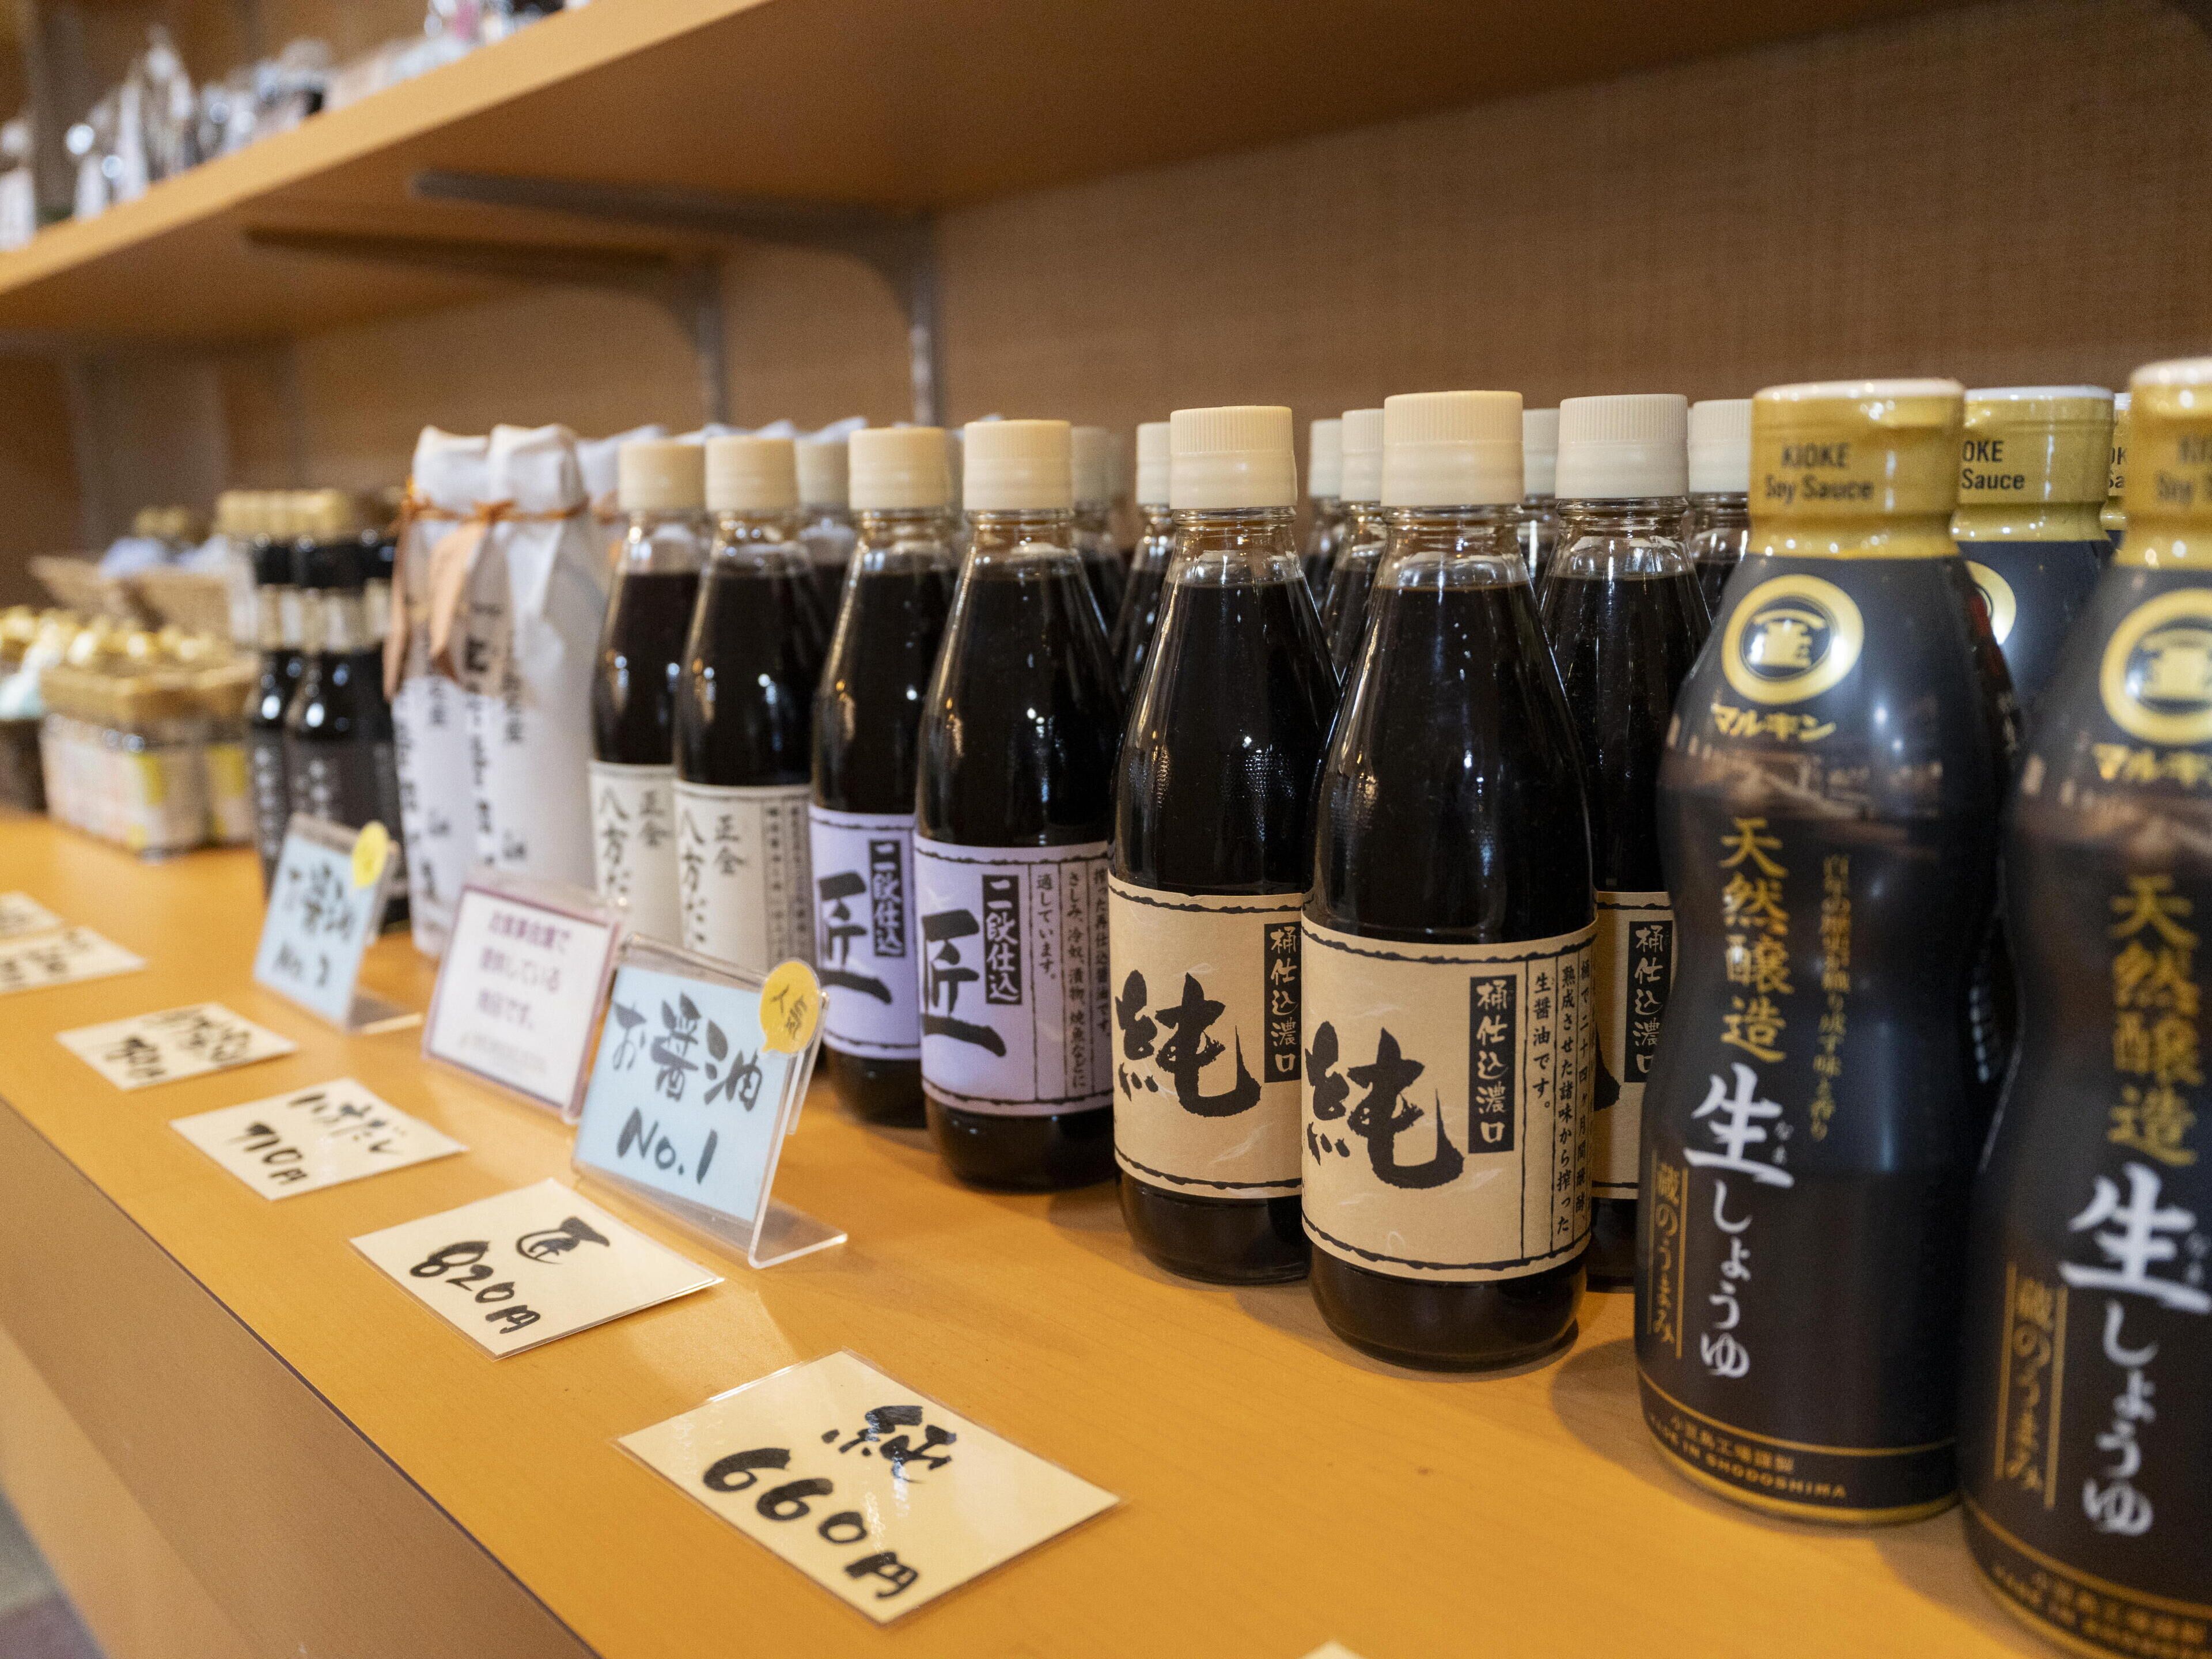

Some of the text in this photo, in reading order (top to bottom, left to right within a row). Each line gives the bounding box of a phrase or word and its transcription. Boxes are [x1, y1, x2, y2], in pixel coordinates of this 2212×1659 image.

[1801, 474, 1874, 501] Sauce
[1961, 467, 2025, 490] Sauce
[1710, 702, 1837, 744] マルキン
[986, 878, 1021, 1002] 二段仕込
[1270, 925, 1298, 1073] 桶仕込濃口
[612, 990, 763, 1112] お醤油
[1115, 969, 1262, 1119] 純
[1475, 979, 1509, 1143] 桶仕込濃口
[1531, 972, 1552, 1108] 生醤油です。
[616, 1107, 718, 1185] No.1
[1304, 1020, 1464, 1190] 純
[409, 1240, 542, 1335] 820円
[702, 1446, 921, 1600] 660円
